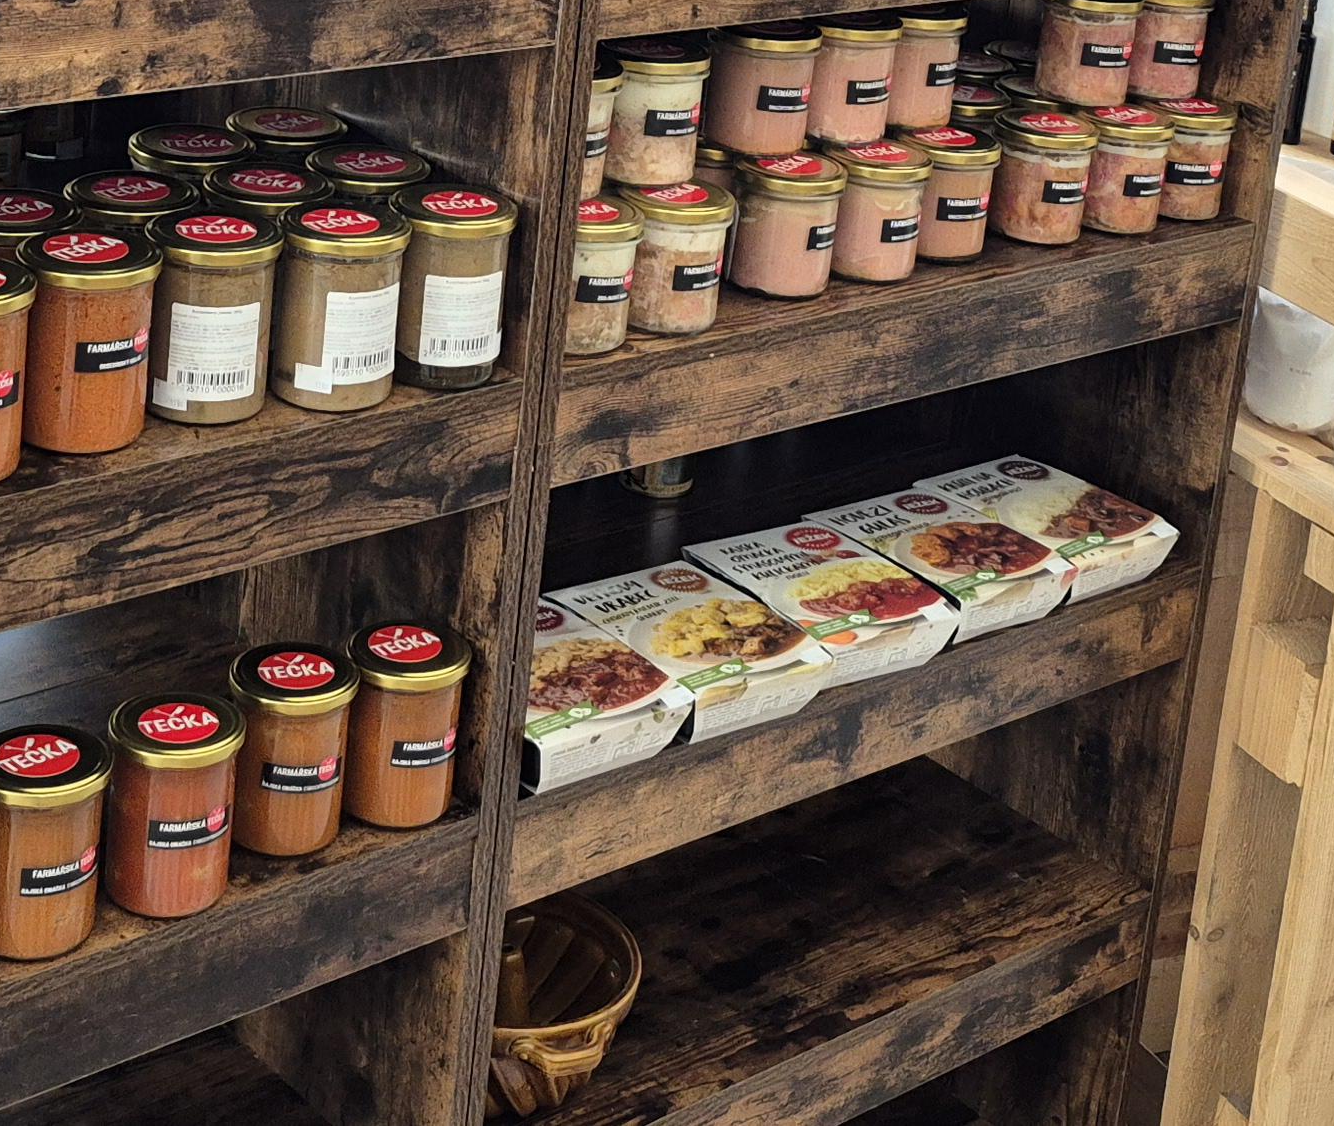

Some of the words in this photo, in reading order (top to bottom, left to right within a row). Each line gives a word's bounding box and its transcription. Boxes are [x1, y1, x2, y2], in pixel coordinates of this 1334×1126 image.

[765, 153, 811, 173] TEČKA
[95, 179, 167, 198] TEČKA
[232, 173, 306, 192] TEČKA
[422, 194, 499, 212] TEČKA
[176, 220, 258, 236] TEČKA
[301, 211, 379, 232] TEČKA
[49, 236, 125, 260] TEČKA
[87, 338, 134, 354] FARMÁŘSKÁ
[595, 589, 660, 615] VRABEC
[370, 631, 441, 656] TEČKA
[258, 661, 335, 680] TEČKA
[138, 710, 219, 735] TEČKA
[403, 739, 443, 751] FARMÁŘSKÁ
[273, 765, 318, 777] FARMÁŘSKÁ
[159, 818, 206, 833] FARMÁŘSKÁ
[32, 861, 80, 879] FARMÁŘSKÁ
